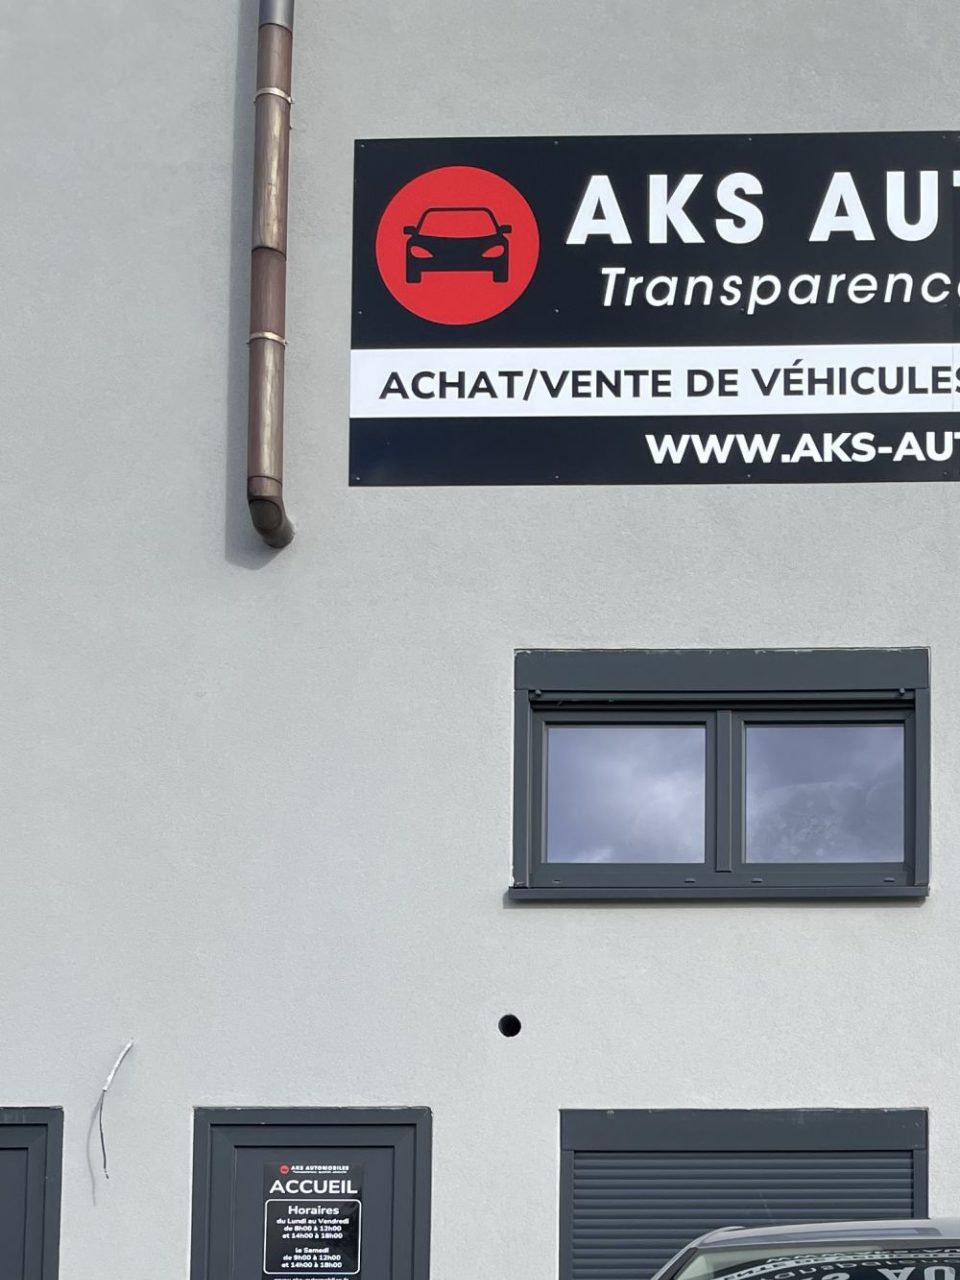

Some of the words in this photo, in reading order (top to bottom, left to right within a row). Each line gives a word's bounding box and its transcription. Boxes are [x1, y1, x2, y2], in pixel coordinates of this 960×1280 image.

[565, 172, 764, 245] AKS
[379, 368, 672, 402] ACHAT/VENTE
[686, 368, 739, 398] DE
[269, 1179, 358, 1194] ACCUEIL
[288, 1205, 340, 1215] Horaires
